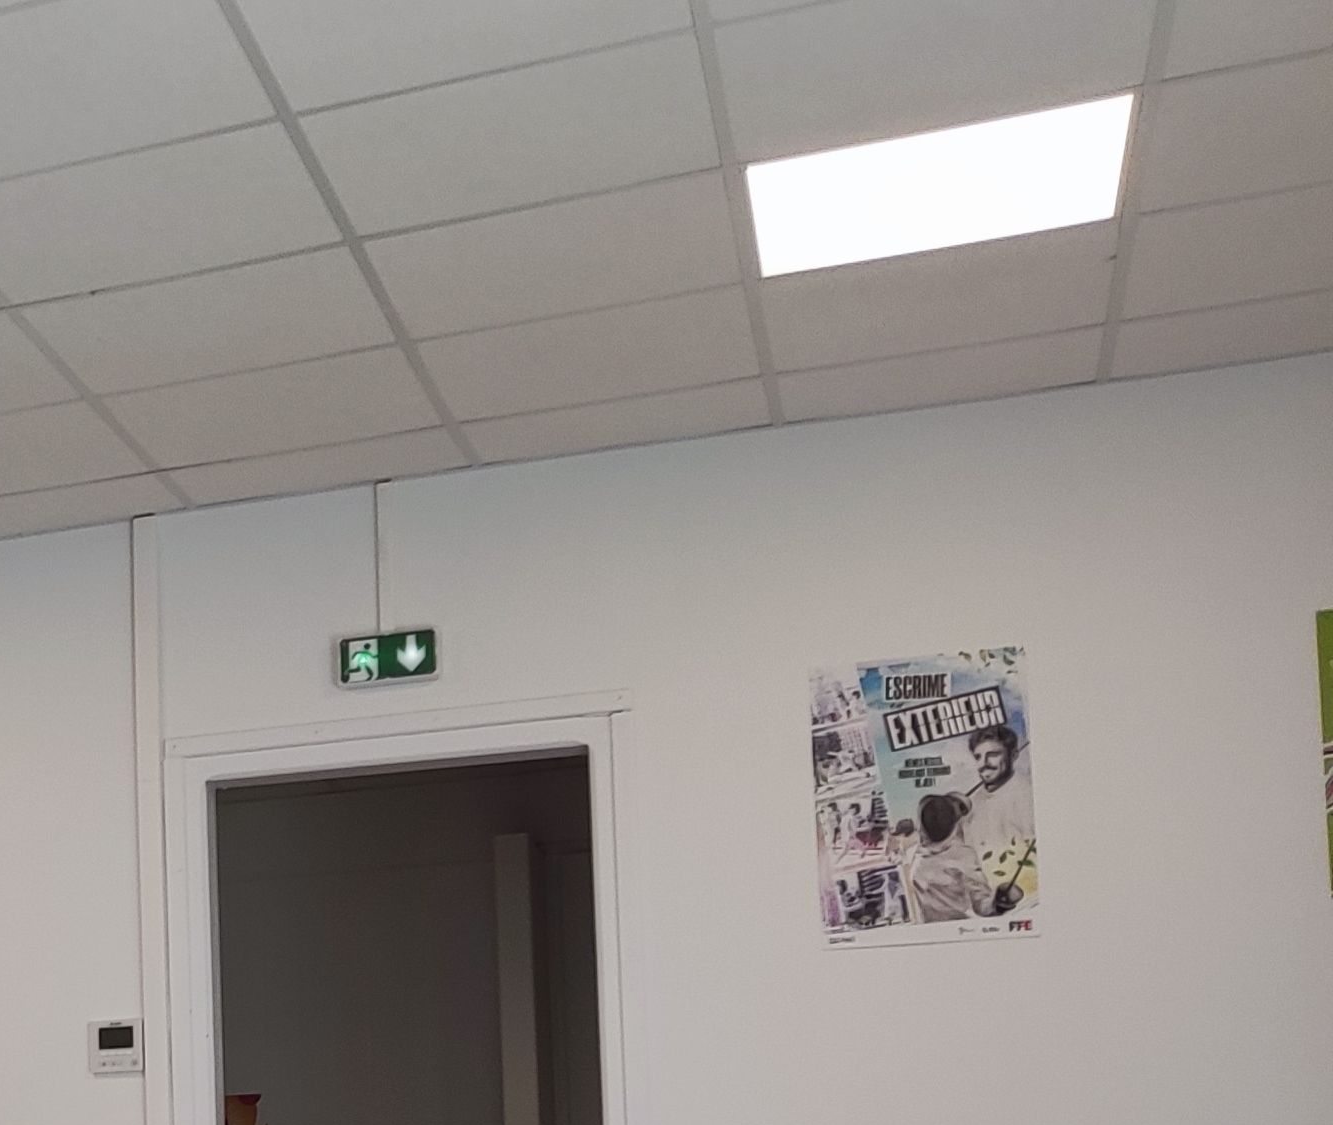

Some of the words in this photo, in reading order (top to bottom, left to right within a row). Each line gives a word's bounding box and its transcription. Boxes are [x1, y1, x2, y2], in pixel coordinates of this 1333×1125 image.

[885, 673, 947, 701] ESCRIME
[886, 689, 1005, 750] EXTERIEUR
[1009, 920, 1032, 931] FFE
